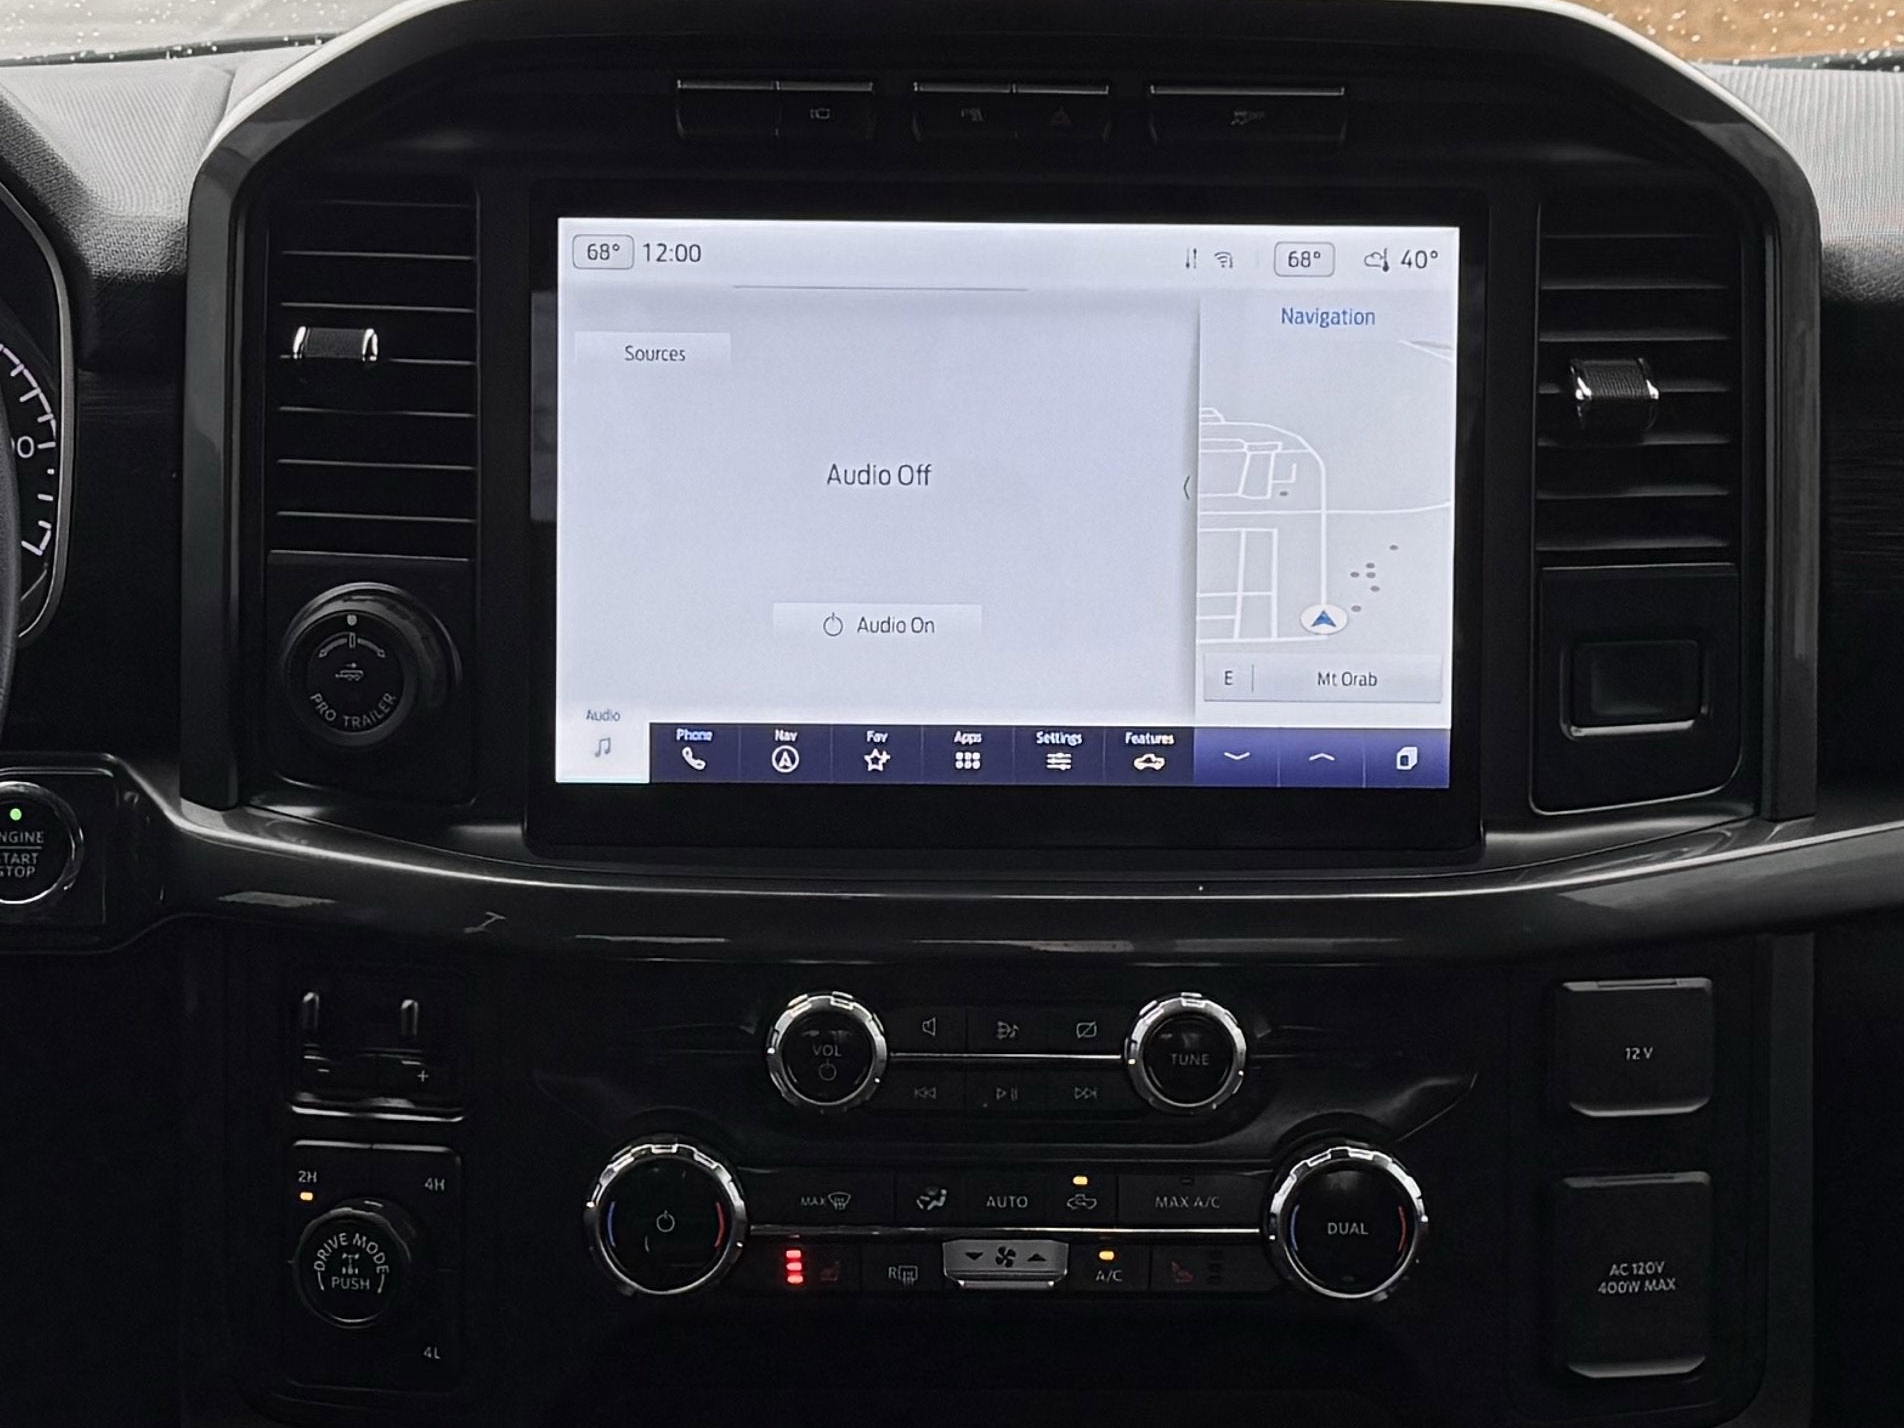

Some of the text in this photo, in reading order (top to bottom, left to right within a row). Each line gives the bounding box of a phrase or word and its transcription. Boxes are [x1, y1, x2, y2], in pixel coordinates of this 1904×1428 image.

[586, 242, 702, 263] 68° 12:00
[1287, 249, 1439, 270] 68° 40°
[1281, 307, 1376, 329] Navigation
[624, 344, 686, 362] Sources
[826, 463, 932, 486] Audio Off
[856, 616, 935, 634] Audio On
[1224, 669, 1233, 686] E
[1317, 671, 1378, 687] Mt Orab
[309, 692, 397, 729] PRO TRAILER
[585, 709, 621, 722] Audio
[676, 727, 713, 741] Phone
[774, 729, 798, 742] Nav
[866, 729, 888, 743] Fav
[953, 730, 982, 745] Apps
[1036, 731, 1083, 746] Settings
[1125, 731, 1175, 745] Features
[813, 1044, 841, 1057] VOL
[1171, 1053, 1209, 1066] TUNE
[298, 1170, 318, 1183] 2H
[424, 1177, 445, 1191] 4H
[800, 1196, 826, 1206] MAX
[986, 1195, 1029, 1209] AUTO
[1155, 1196, 1219, 1208] MAX A/C
[1327, 1221, 1369, 1236] DUAL
[313, 1232, 391, 1275] DRIVE MODE
[1095, 1269, 1122, 1282] A/C
[1609, 1261, 1665, 1277] AC 120V
[330, 1275, 371, 1292] PUSH
[1598, 1278, 1676, 1294] 400W MAX
[423, 1346, 441, 1360] 4L
